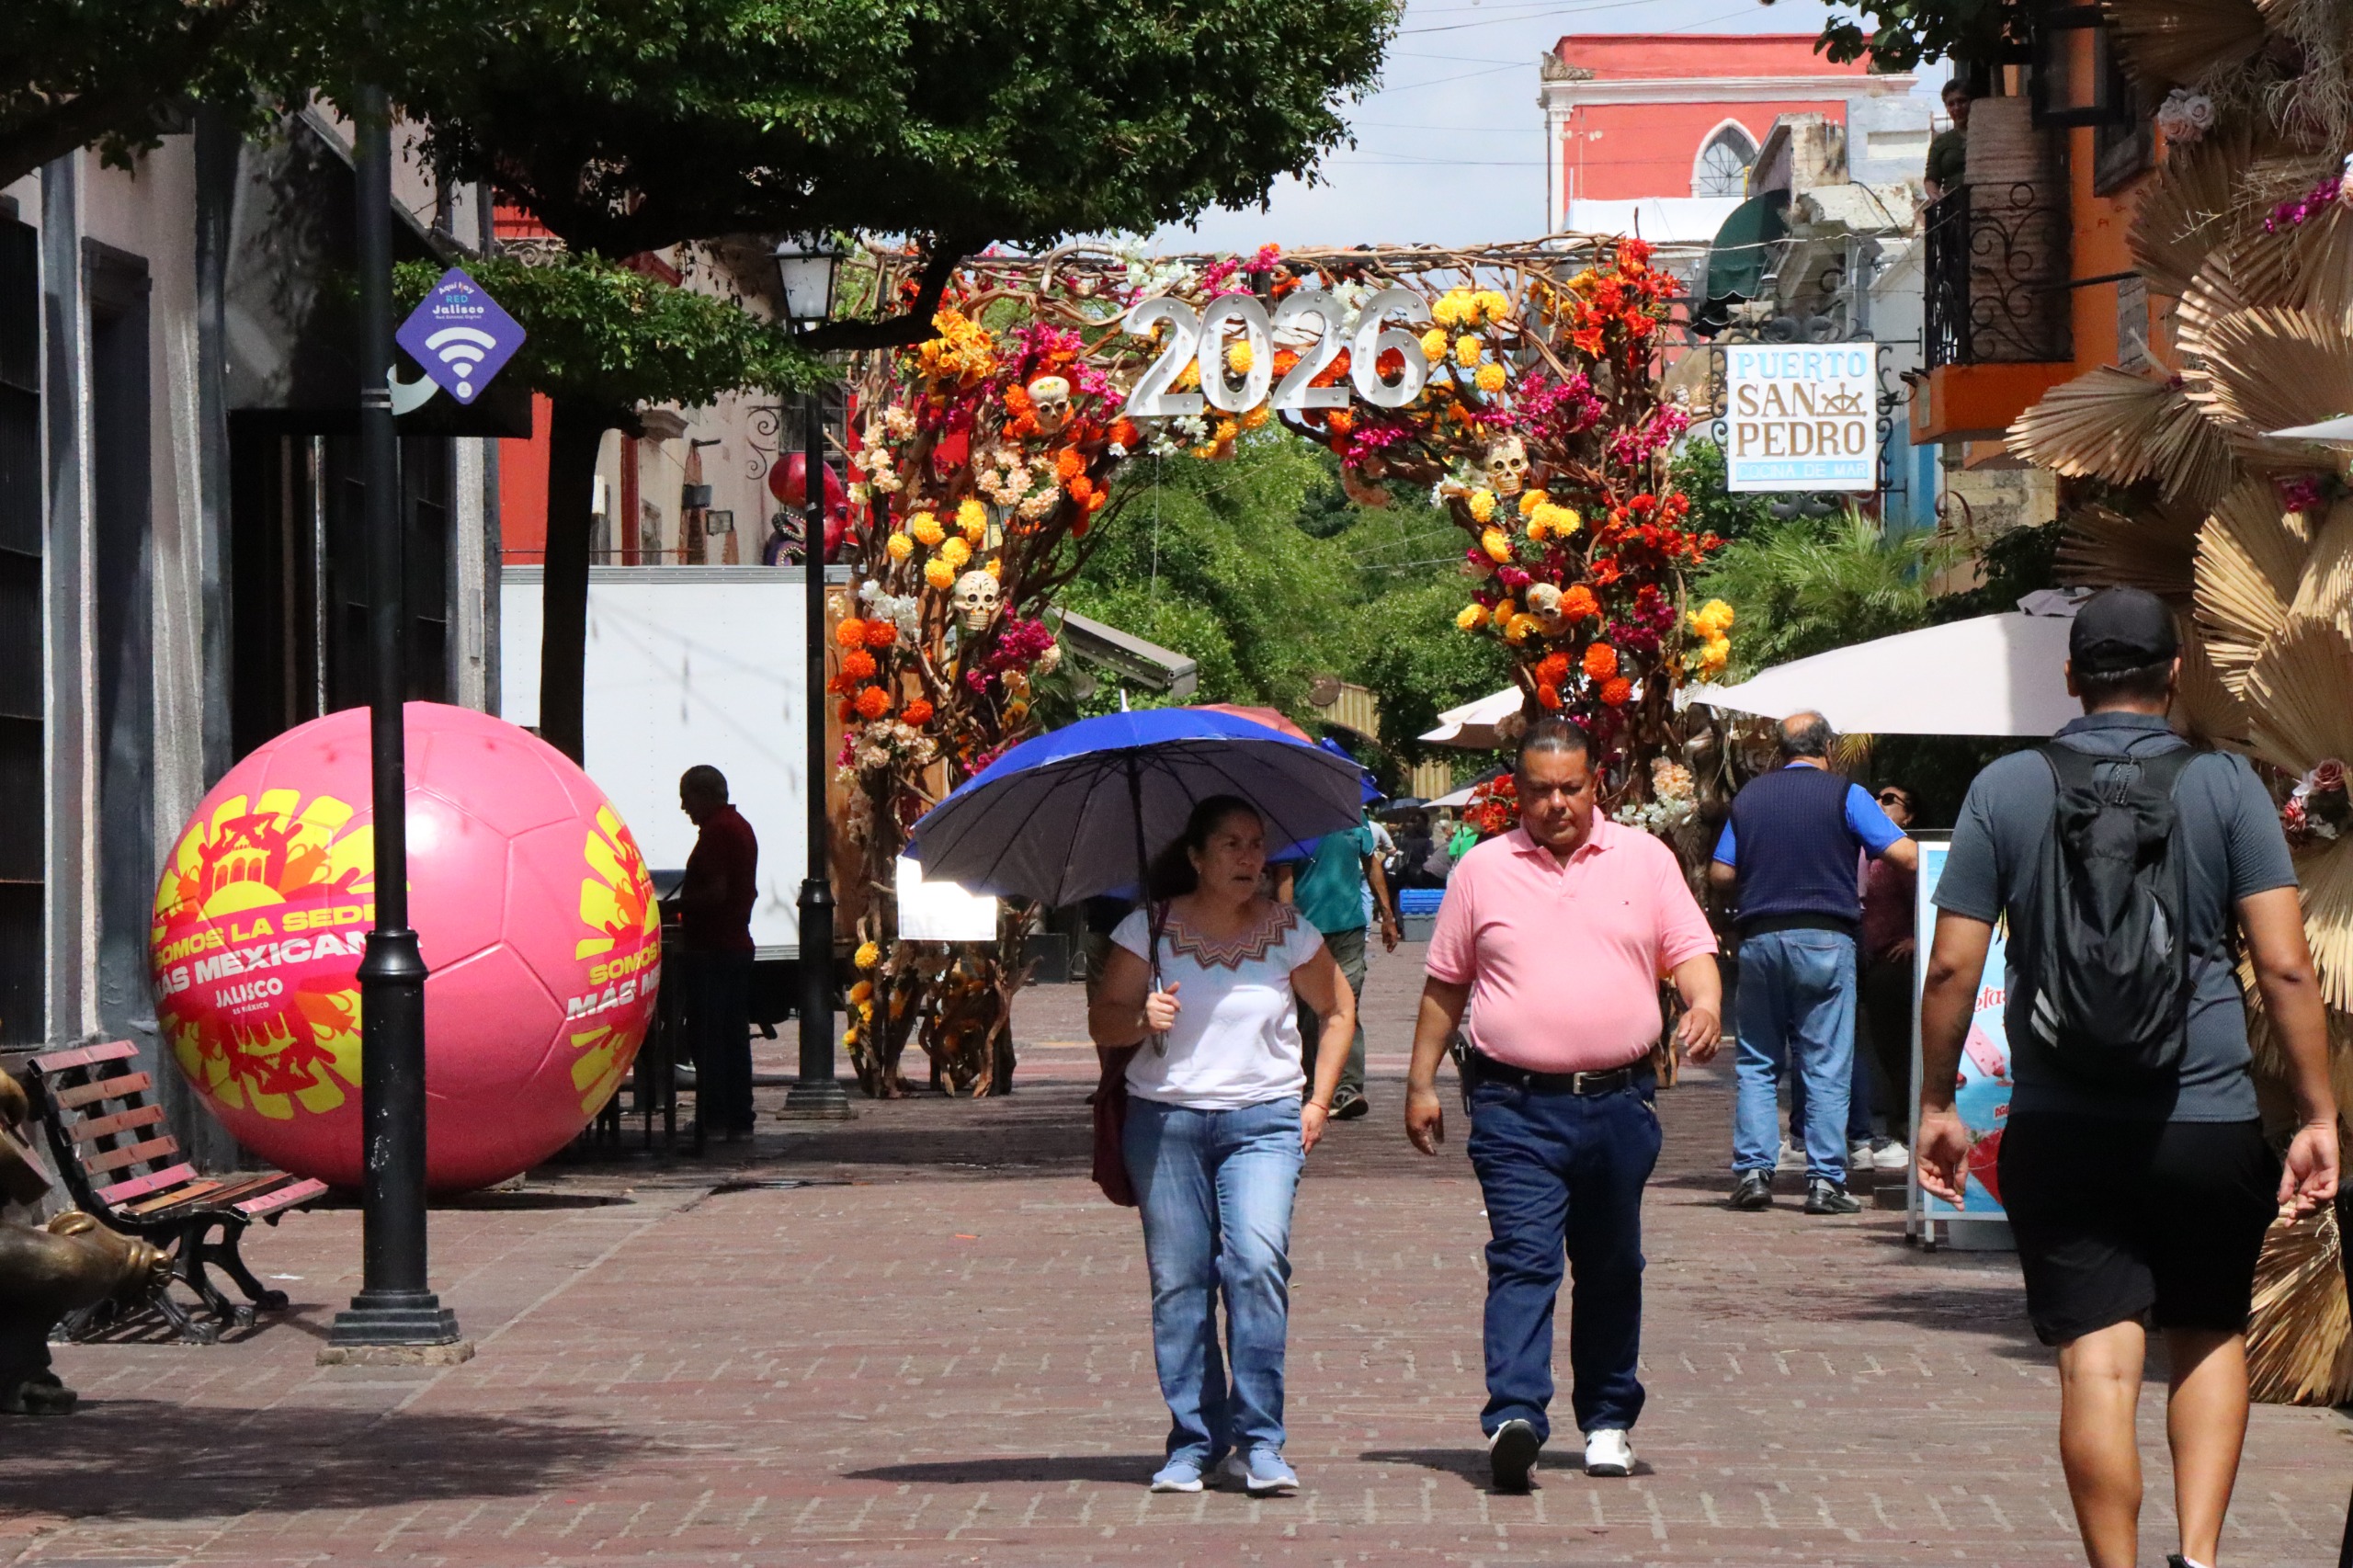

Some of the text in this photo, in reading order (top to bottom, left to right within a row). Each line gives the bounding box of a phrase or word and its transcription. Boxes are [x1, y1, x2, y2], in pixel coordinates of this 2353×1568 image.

[432, 304, 484, 314] Jalisco
[446, 295, 469, 303] RED
[1123, 289, 1431, 415] 2026
[1735, 350, 1868, 382] PUERTO
[1736, 382, 1817, 417] SAN
[1735, 421, 1867, 457] PEDRO
[1738, 462, 1867, 479] COCINA DE MAR
[154, 926, 224, 970] SOMOS
[231, 917, 274, 943] LA
[589, 941, 657, 985] SOMOS
[215, 978, 283, 1008] JALISCO
[242, 1001, 269, 1013] MÉXICO
[565, 979, 637, 1021] MÁS
